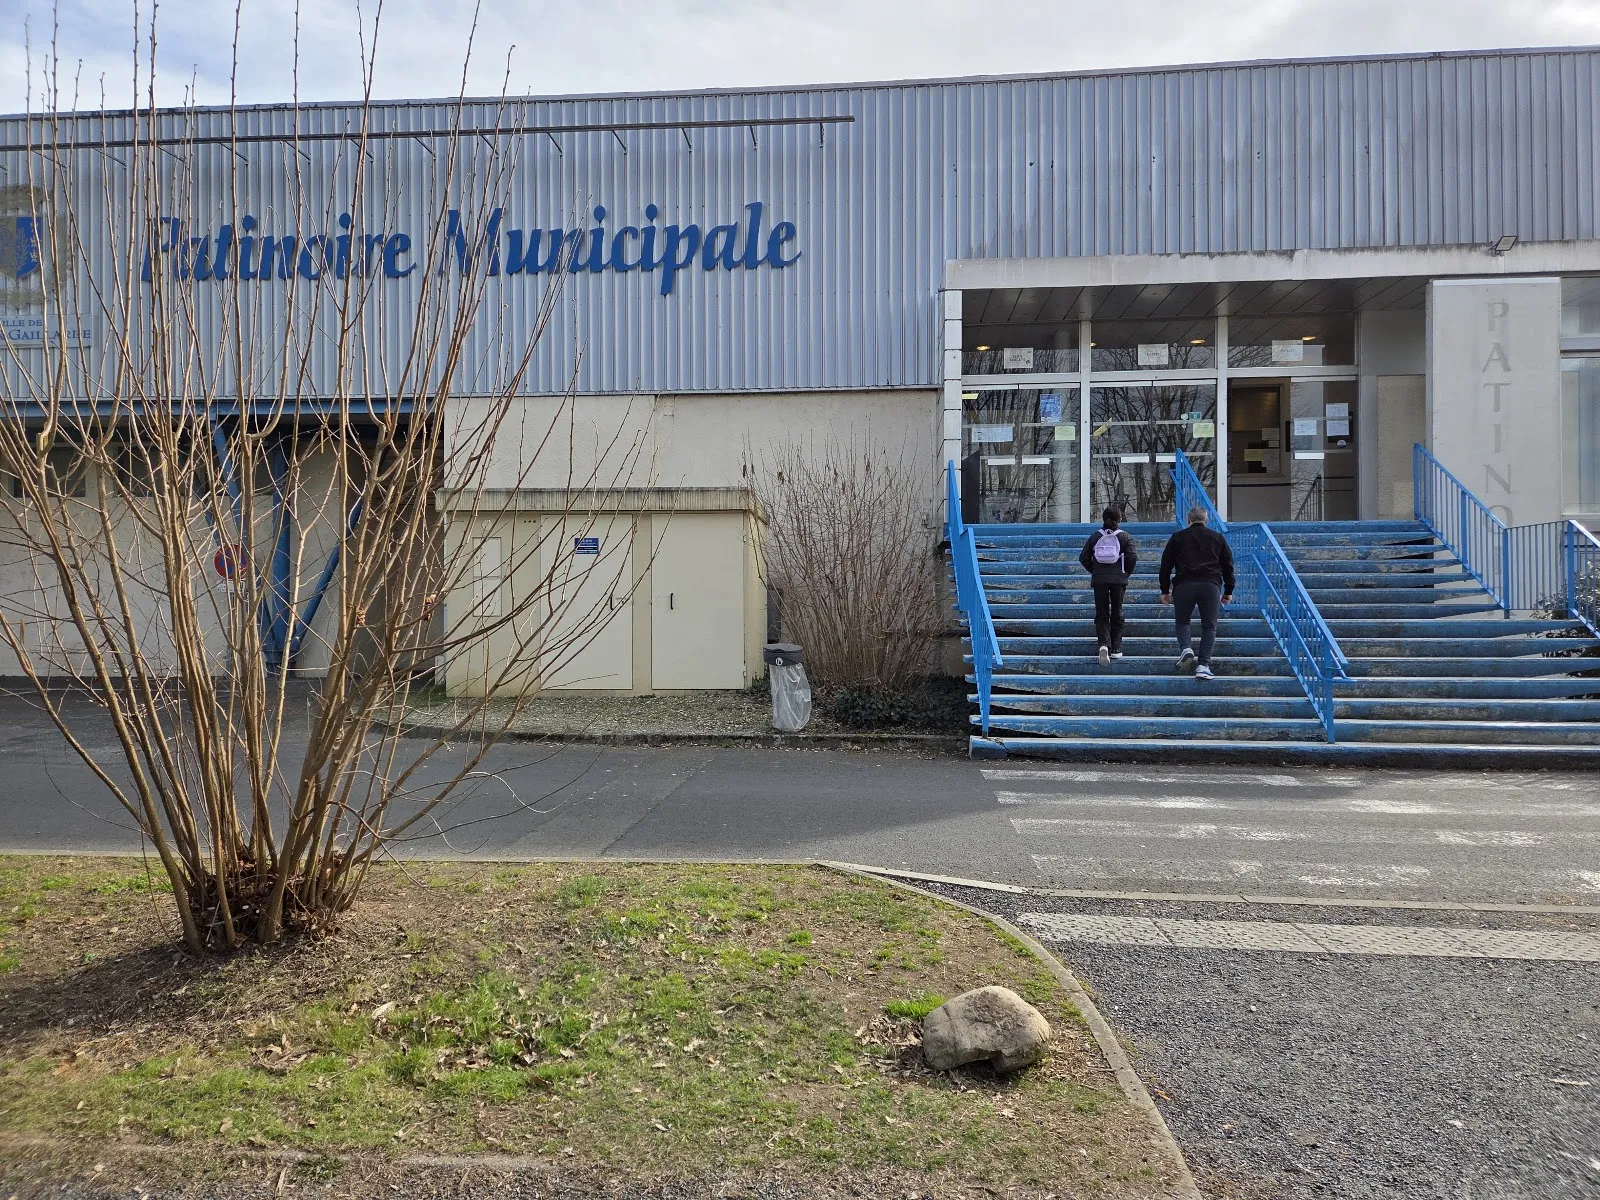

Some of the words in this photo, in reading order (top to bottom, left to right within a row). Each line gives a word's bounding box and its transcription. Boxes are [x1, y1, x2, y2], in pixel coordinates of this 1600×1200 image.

[141, 212, 417, 281] Patinoire
[437, 201, 803, 296] Municipale
[1, 319, 25, 327] ILLE
[28, 319, 43, 327] DE
